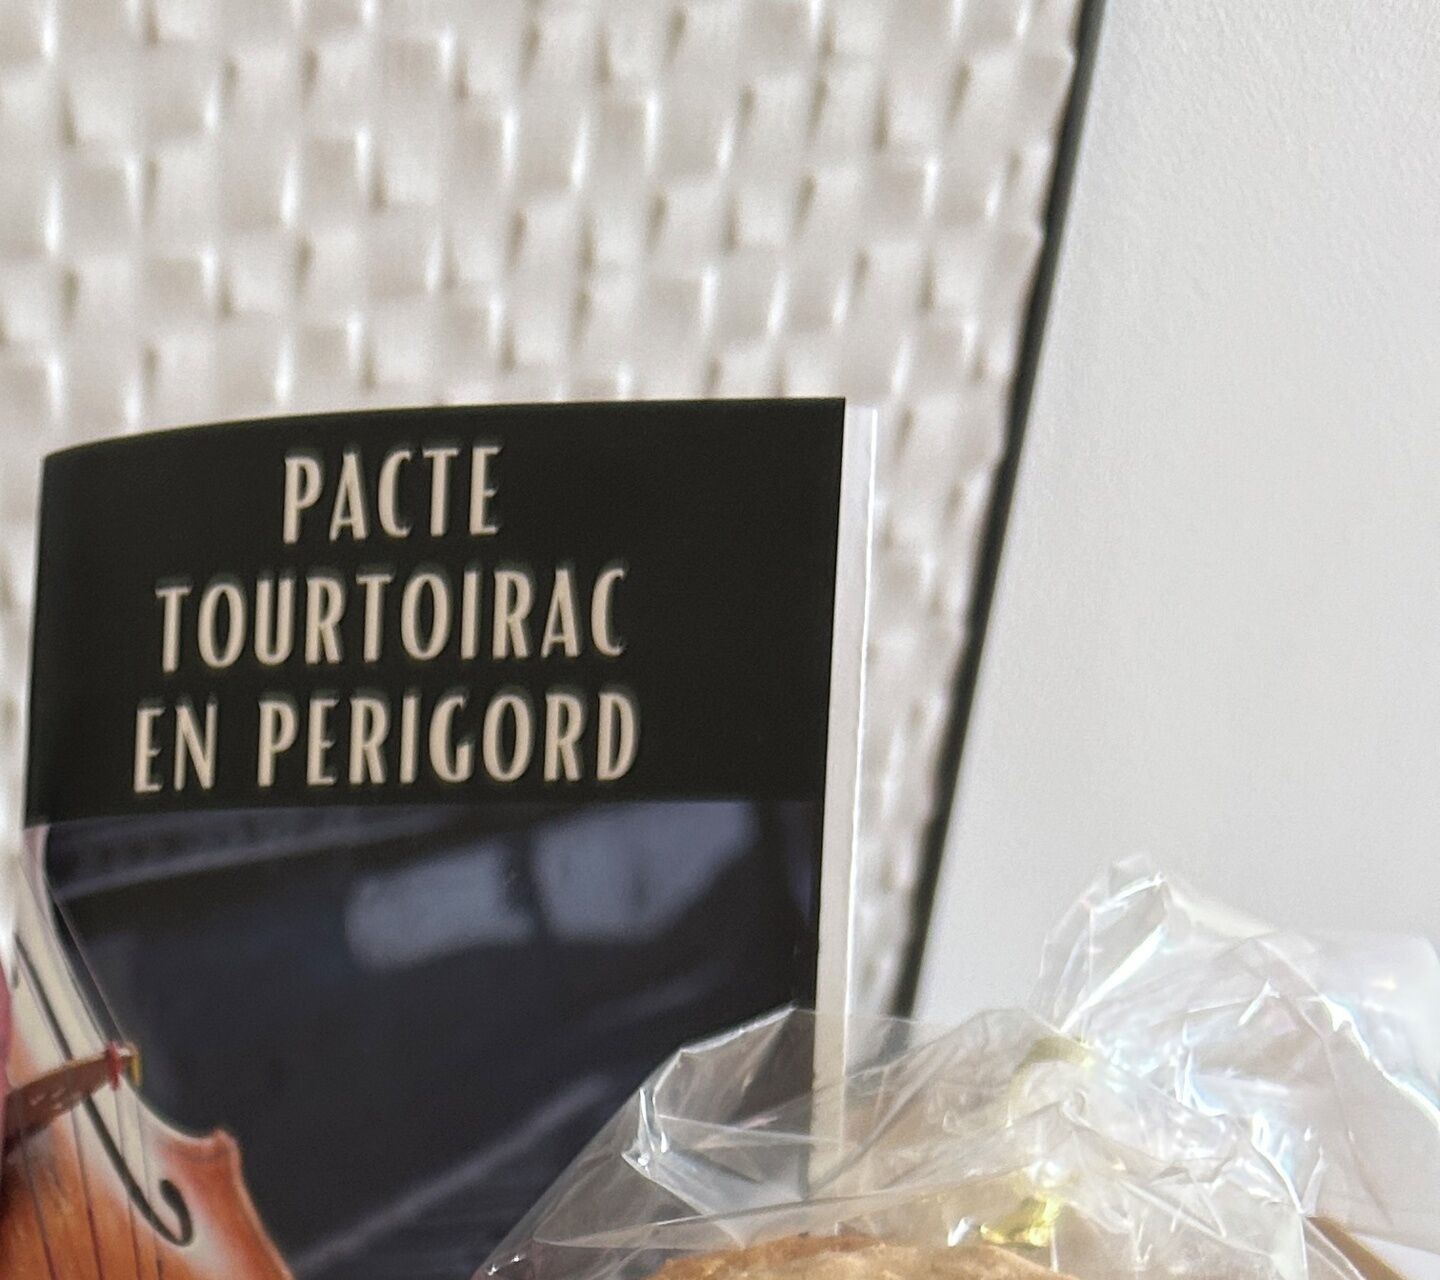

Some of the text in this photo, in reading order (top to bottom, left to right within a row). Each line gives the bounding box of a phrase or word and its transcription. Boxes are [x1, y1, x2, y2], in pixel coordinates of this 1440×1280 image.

[282, 445, 502, 543] PACTE
[156, 564, 629, 673] TOURTOIRAC
[133, 691, 640, 793] EN PERIGORD
